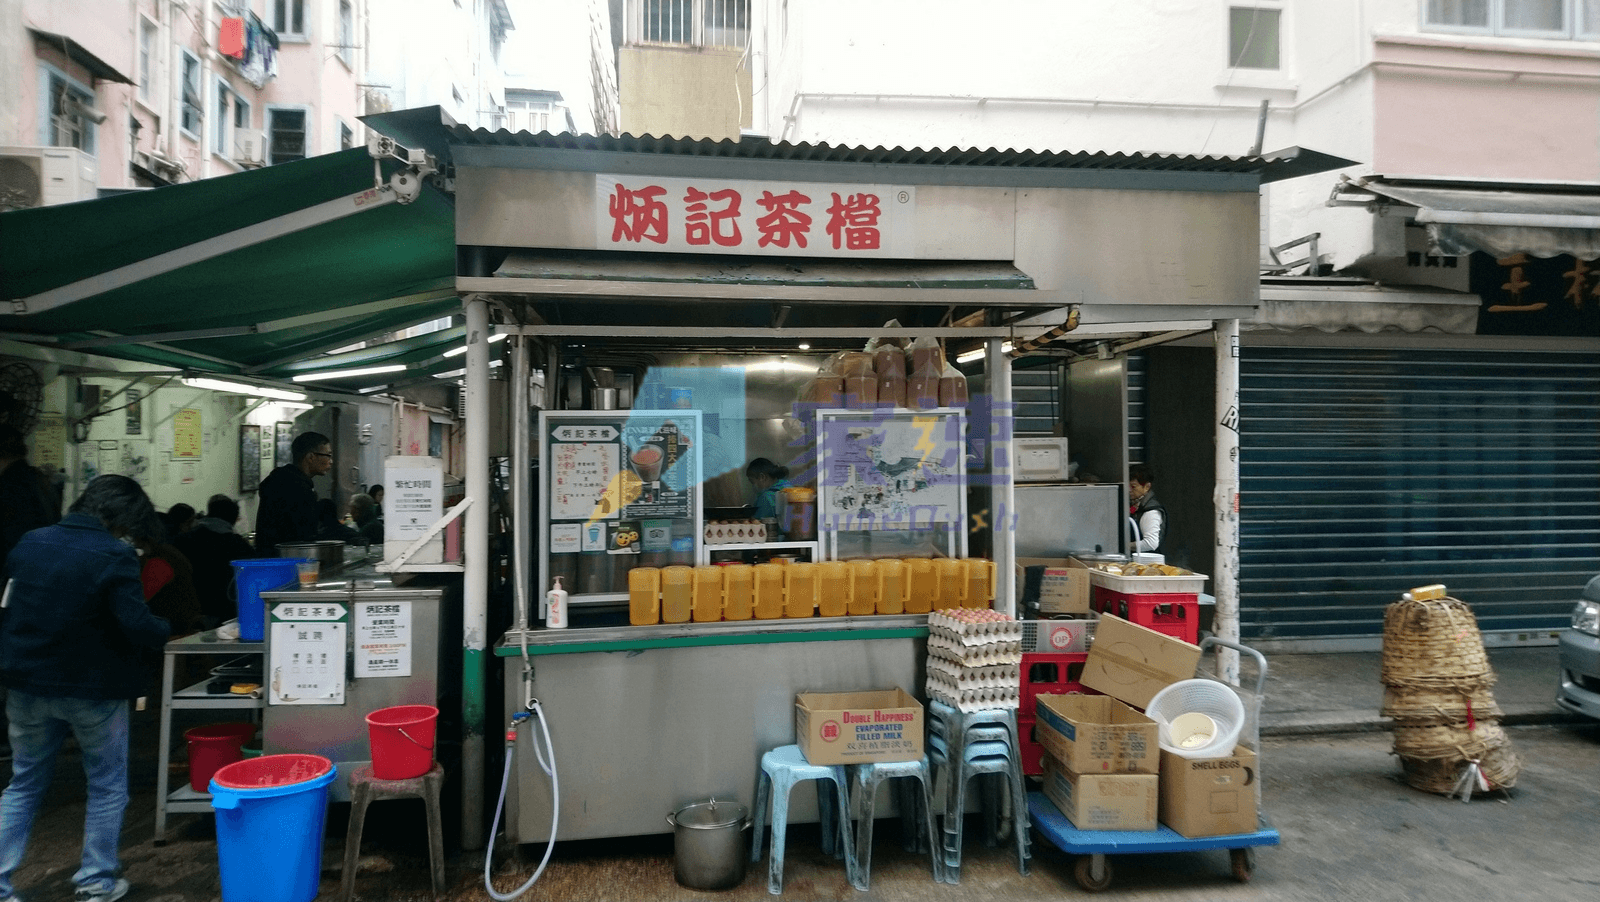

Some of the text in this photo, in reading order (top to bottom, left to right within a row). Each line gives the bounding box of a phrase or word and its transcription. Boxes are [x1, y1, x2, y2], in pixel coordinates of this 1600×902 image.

[609, 183, 881, 250] 炳記茶檔
[562, 429, 610, 438] 炳記茶檔
[283, 607, 337, 617] 炳記茶檔
[855, 723, 903, 733] EVAPORATED
[856, 732, 903, 741] FILLED MILK
[1192, 760, 1240, 770] SHELL EGGS
